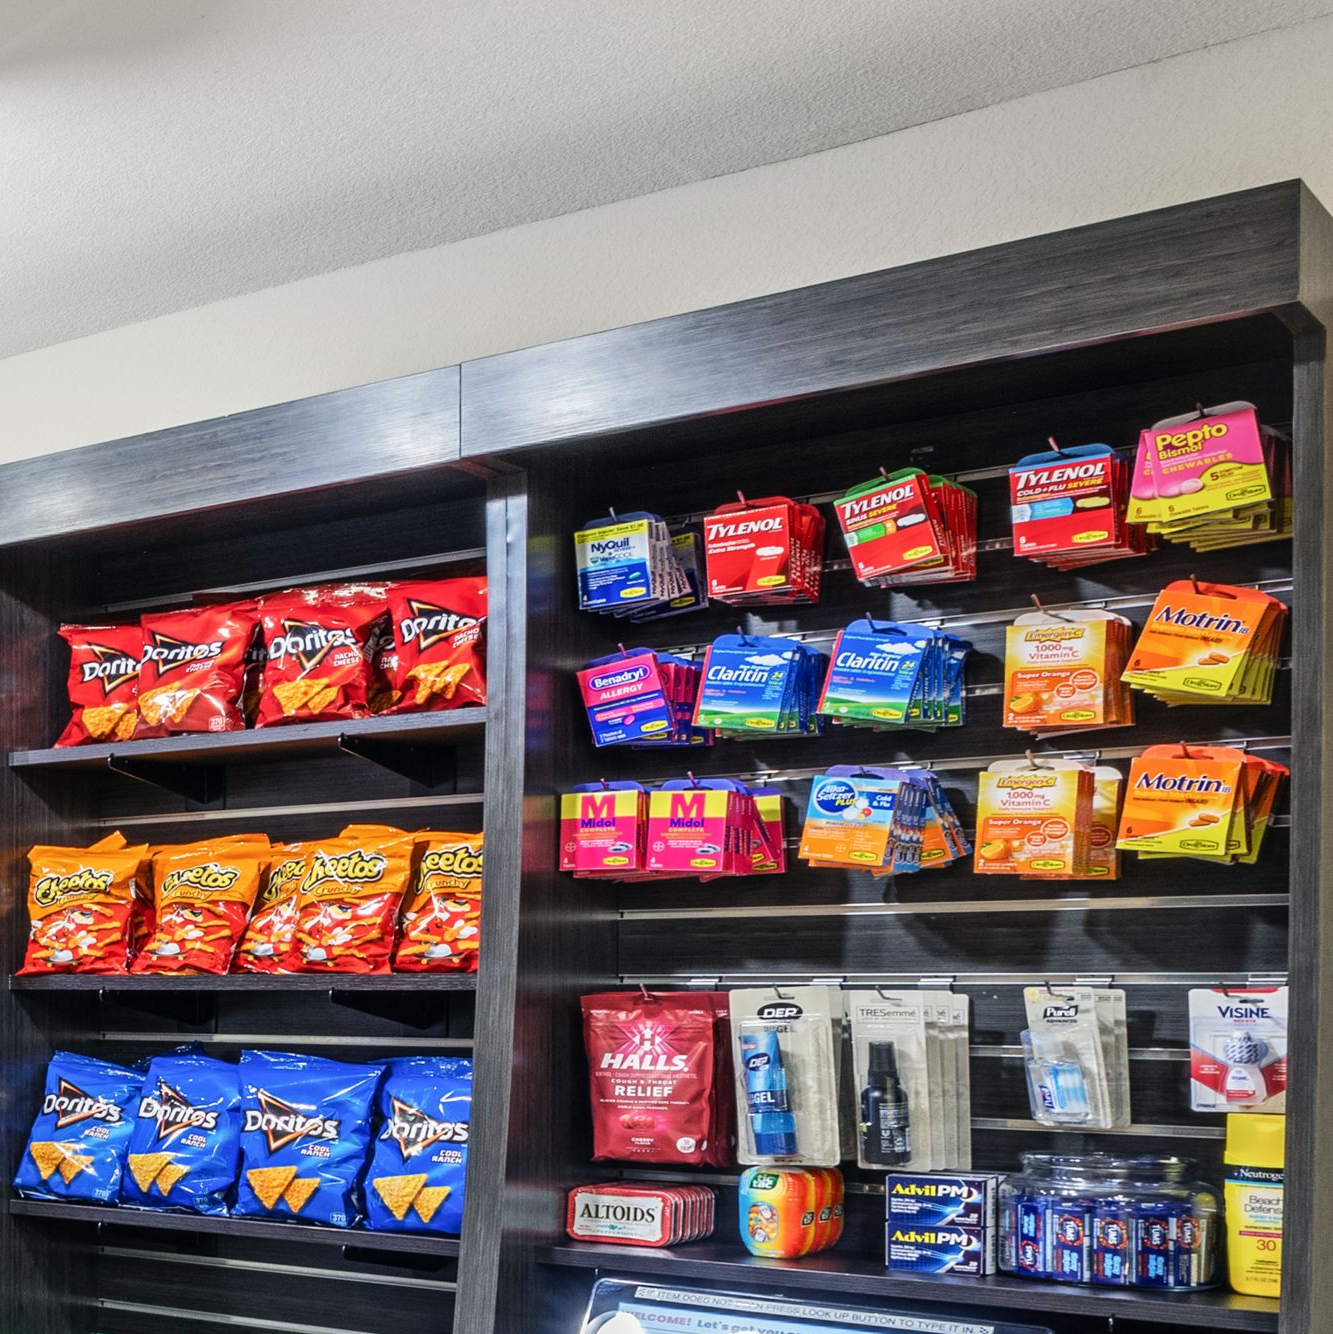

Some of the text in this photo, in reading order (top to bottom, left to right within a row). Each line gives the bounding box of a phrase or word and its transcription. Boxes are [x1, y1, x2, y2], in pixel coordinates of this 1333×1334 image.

[1156, 423, 1229, 451] Pepto
[1158, 442, 1204, 461] Bismol
[1015, 461, 1106, 490] TYLENOL
[840, 483, 915, 522] TYLENOL
[846, 504, 898, 525] SINUS SEVERE
[707, 515, 783, 541] TYLENOL
[591, 537, 630, 554] NyQuil
[1155, 605, 1245, 633] Motrin
[142, 640, 223, 664] Doritos
[269, 629, 356, 660] Doritos
[836, 652, 900, 674] Claritin
[1029, 650, 1065, 660] Vitamin
[593, 667, 646, 688] Benadryl
[708, 664, 768, 684] Claritin
[1017, 669, 1071, 681] Super Orange
[600, 683, 643, 700] ALLERGY
[1135, 770, 1225, 793] Motrin
[835, 797, 857, 807] PLUS
[1001, 799, 1036, 807] Vitamin
[580, 817, 616, 828] Midol
[669, 817, 705, 828] Midol
[989, 818, 1042, 827] Super Orange
[302, 850, 383, 889] Cheetos
[35, 870, 110, 906] Cheetos
[859, 1006, 917, 1018] TRESemmé
[1218, 1005, 1271, 1019] VISINE
[614, 1085, 674, 1097] RELIEF
[44, 1093, 122, 1123] Doritos
[139, 1095, 218, 1129] Doritos
[244, 1109, 340, 1139] Doritos
[382, 1116, 469, 1143] Doritos
[300, 1148, 331, 1158] RANCH
[309, 1144, 331, 1153] COOL
[439, 1149, 462, 1158] COOL
[431, 1154, 462, 1165] RANCH
[891, 1184, 969, 1198] Advil PM
[580, 1203, 656, 1222] ALTOIDS
[891, 1229, 969, 1246] Advil PM
[1256, 1239, 1276, 1252] 30
[658, 1291, 680, 1300] ITEM
[684, 1294, 709, 1304] DOES
[765, 1303, 800, 1314] PRESS
[802, 1307, 831, 1318] LOOK
[834, 1312, 849, 1320] UP
[853, 1313, 895, 1326] BUTTON
[900, 1319, 914, 1328] TO
[918, 1320, 946, 1332] TYPE
[949, 1325, 959, 1333] IT
[697, 1318, 730, 1332] Let's
